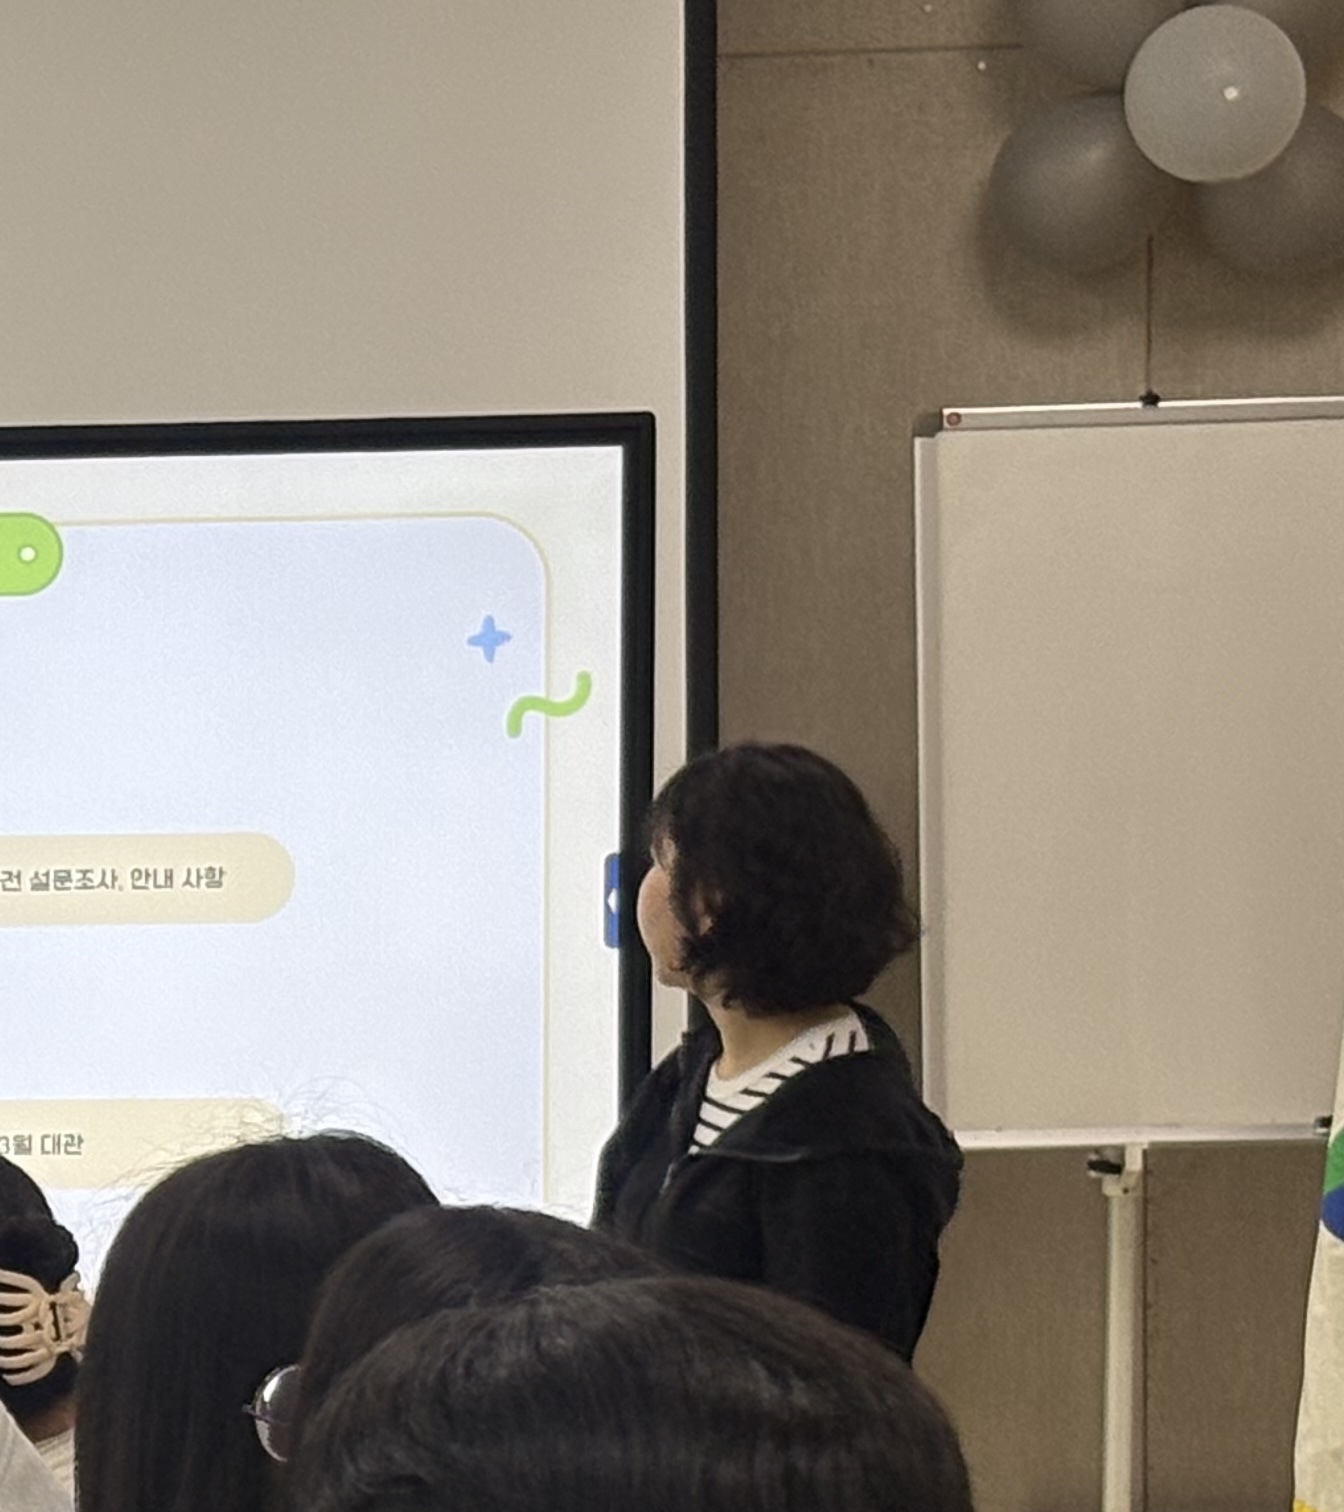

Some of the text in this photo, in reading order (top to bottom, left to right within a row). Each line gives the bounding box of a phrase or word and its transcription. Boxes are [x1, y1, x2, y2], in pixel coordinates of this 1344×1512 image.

[29, 867, 124, 892] 설문조사,
[130, 867, 174, 891] 안내
[182, 865, 227, 890] 사항
[40, 1132, 85, 1156] 대관
